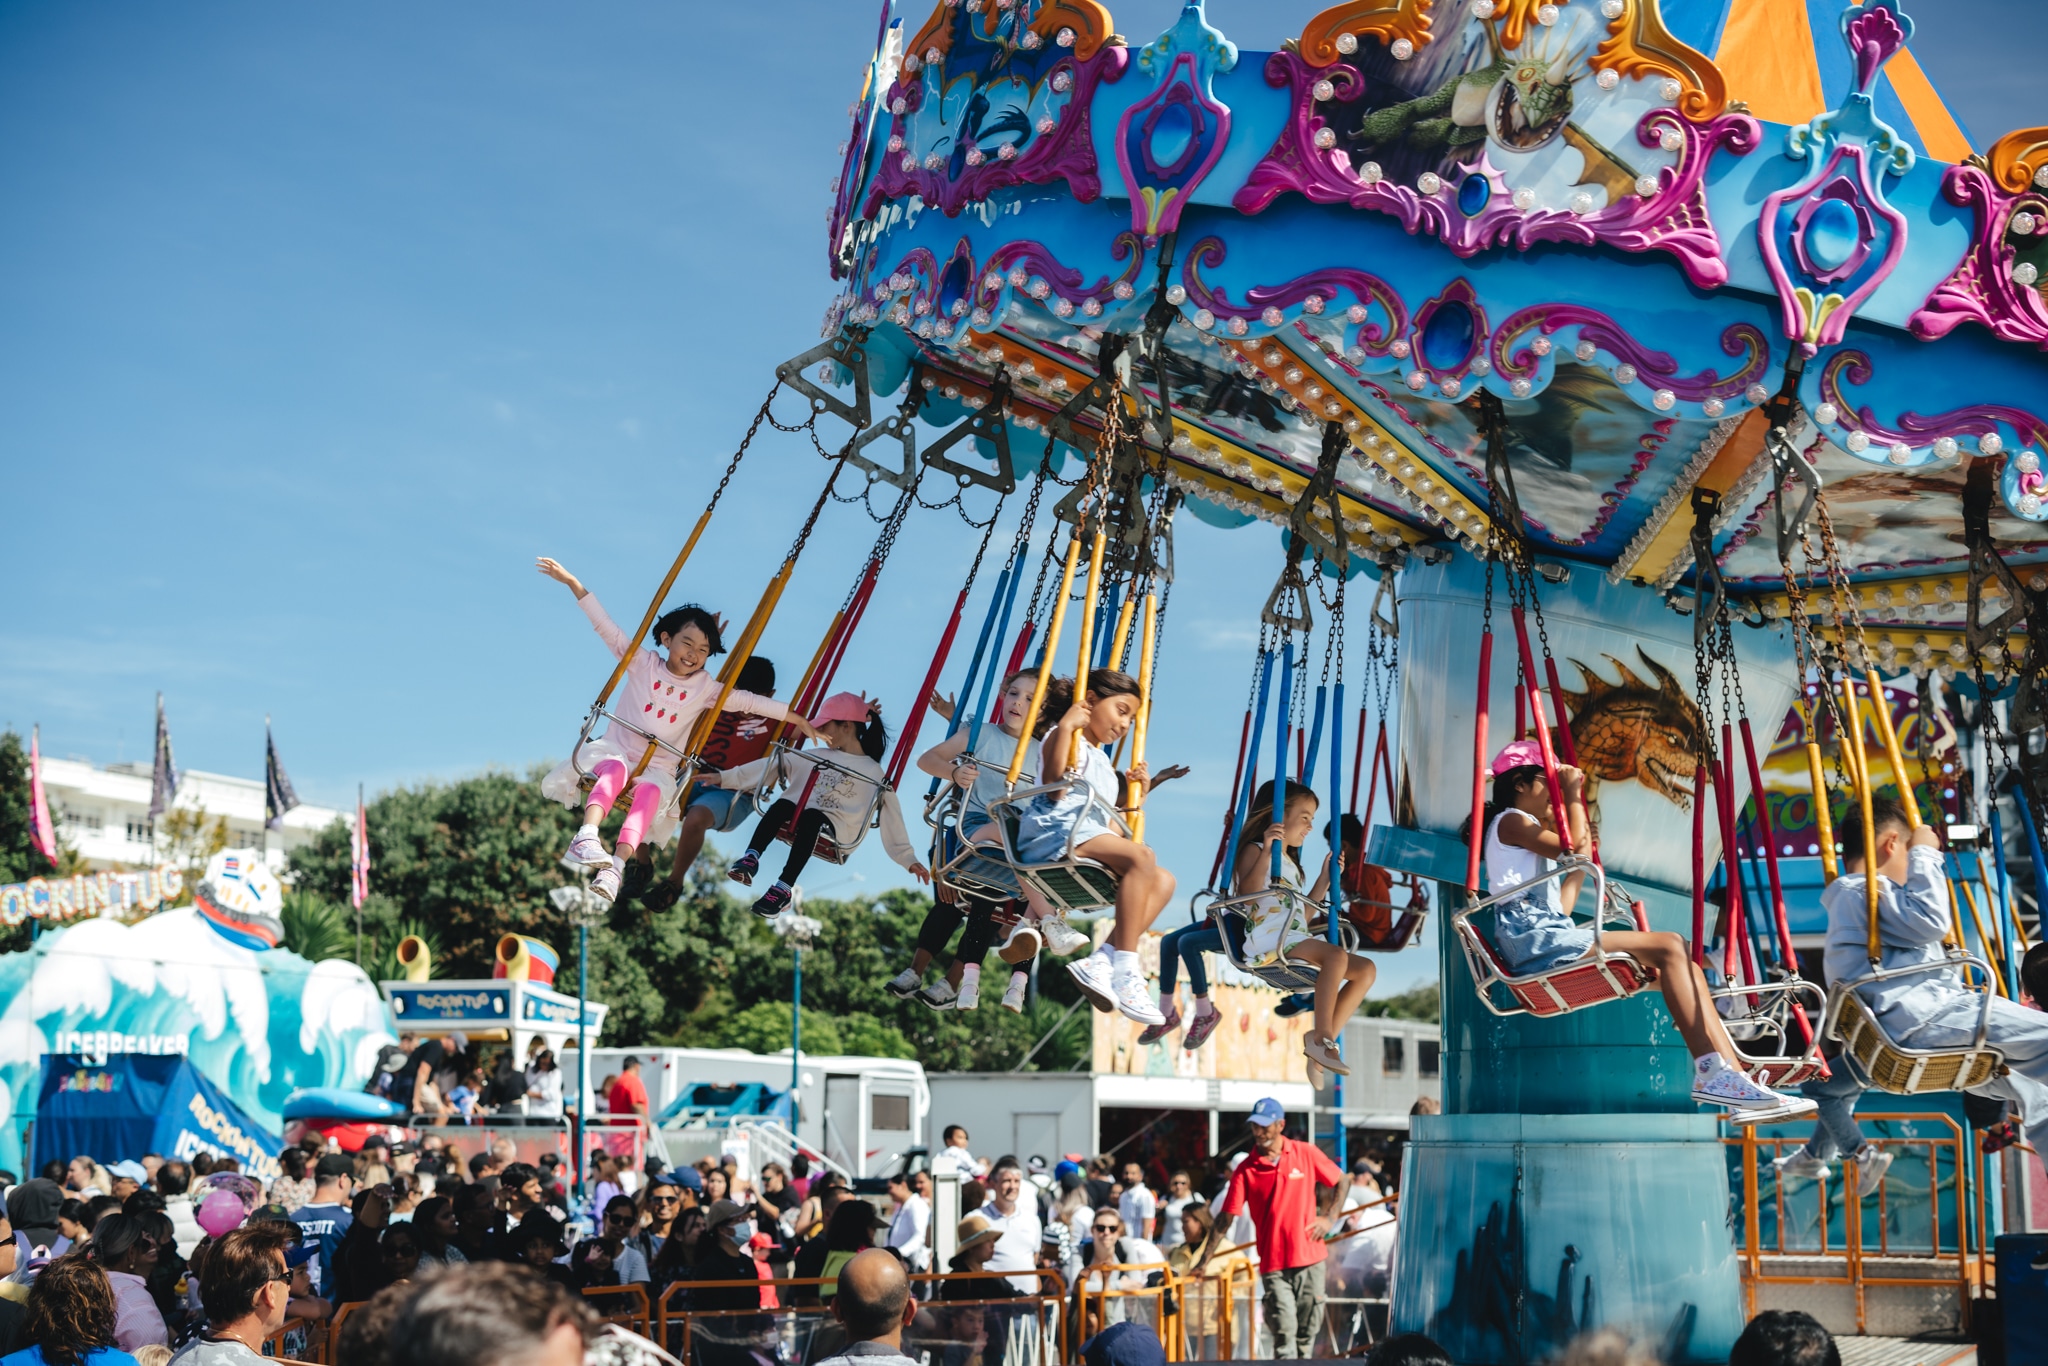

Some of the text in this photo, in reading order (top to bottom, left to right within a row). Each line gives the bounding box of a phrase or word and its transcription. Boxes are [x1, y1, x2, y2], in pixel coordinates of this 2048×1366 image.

[1769, 695, 1936, 758] YNG
[0, 862, 183, 926] OCKIN'TUG
[297, 1219, 336, 1236] ESCOTT
